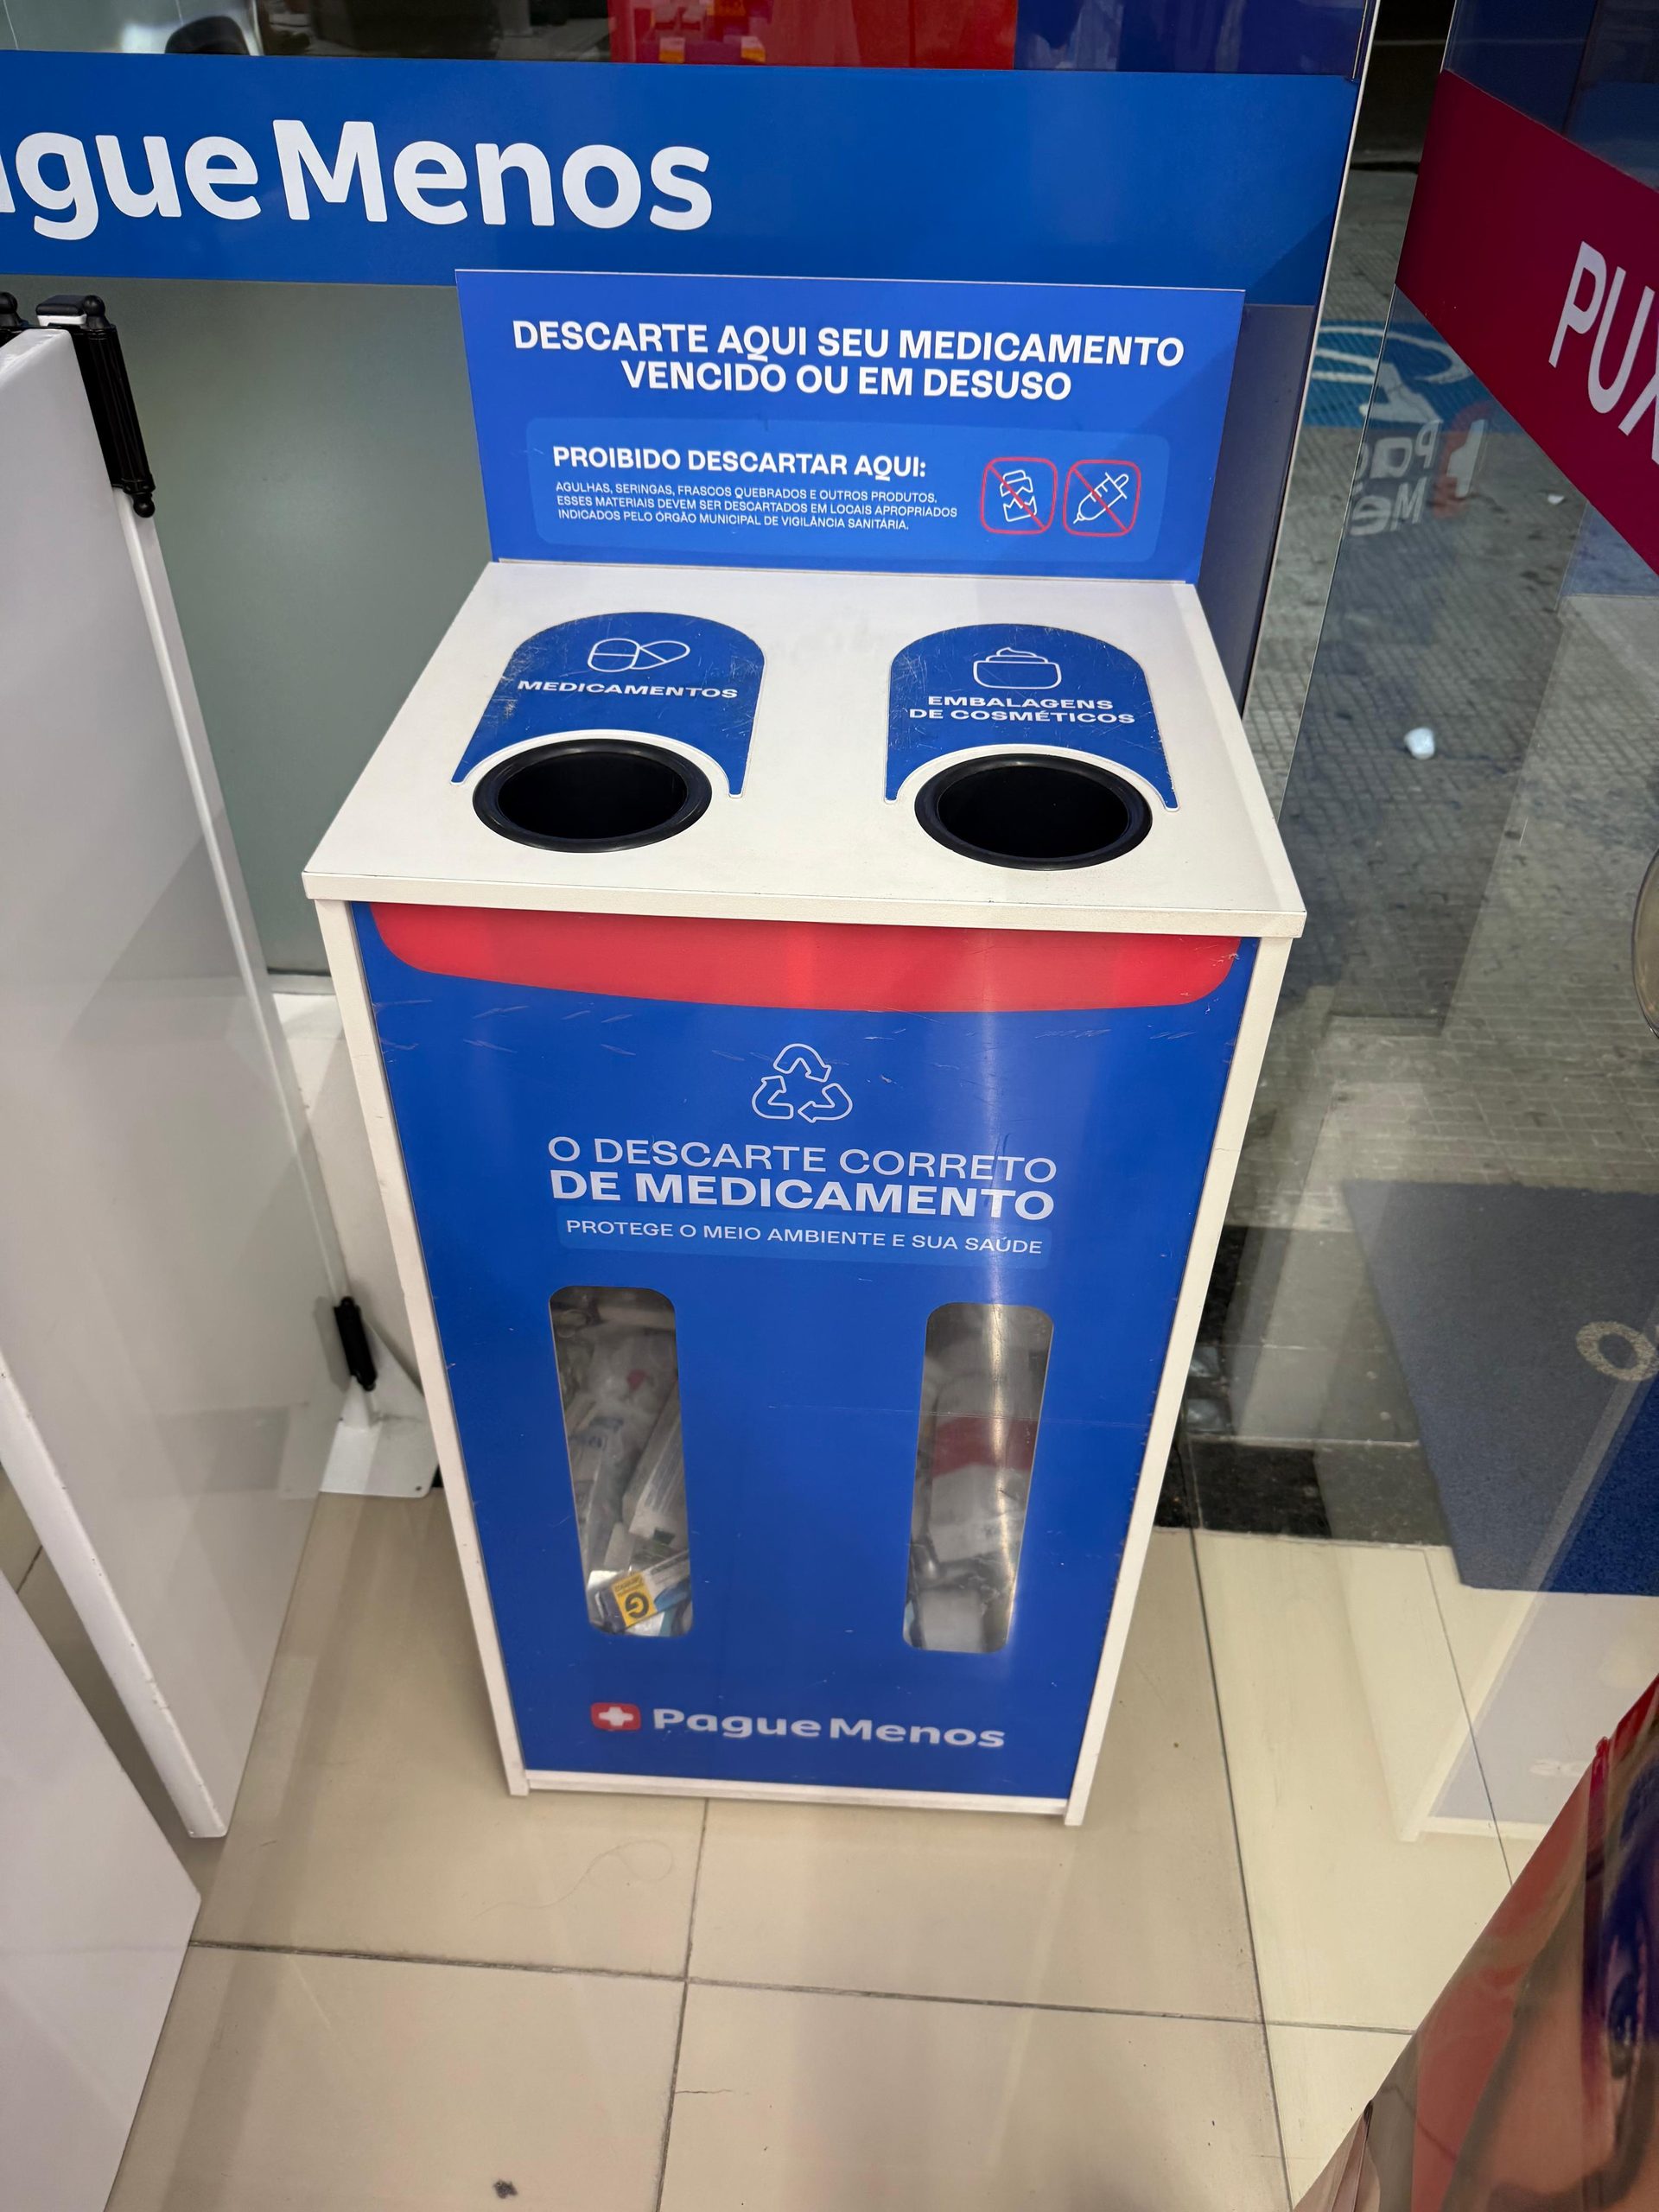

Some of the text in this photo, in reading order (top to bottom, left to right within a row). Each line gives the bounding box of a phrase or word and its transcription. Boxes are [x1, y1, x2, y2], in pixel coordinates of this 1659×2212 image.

[0, 119, 712, 240] gue Menos
[513, 321, 1184, 366] DESCARTE AQUI SEU MEDICAMENTO
[621, 360, 1071, 400] VENCIDO OU EM DESUSO
[553, 447, 925, 481] PROIBIDO DESCARTAR AQUI:
[556, 482, 937, 503] AGULHAS, SERINGAS, FRASCOS QUEBRADOS E OUTROS PRODUTOS.
[557, 495, 957, 518] ESSES MATERIAIS DEVEM SER DESCARTADOS EM LOCAIS APROPRIADOS
[558, 509, 908, 530] INDICADOS PELO ÓRGÃO MUNICIPAL DE VIGILÂNCIA SANITÁRIA.
[518, 680, 737, 698] MEDICAMENTOS
[928, 696, 1113, 709] EMBALAGENS
[910, 709, 1135, 723] DE COSMÉTICOS
[549, 1136, 1057, 1183] O DESCARTE CORRETO
[550, 1170, 1054, 1221] DE MEDICAMENTO
[567, 1220, 1042, 1255] PROTEGE O MEIO AMBIENTE E SUA SAÚDE
[653, 1709, 1004, 1747] Pague Menos
